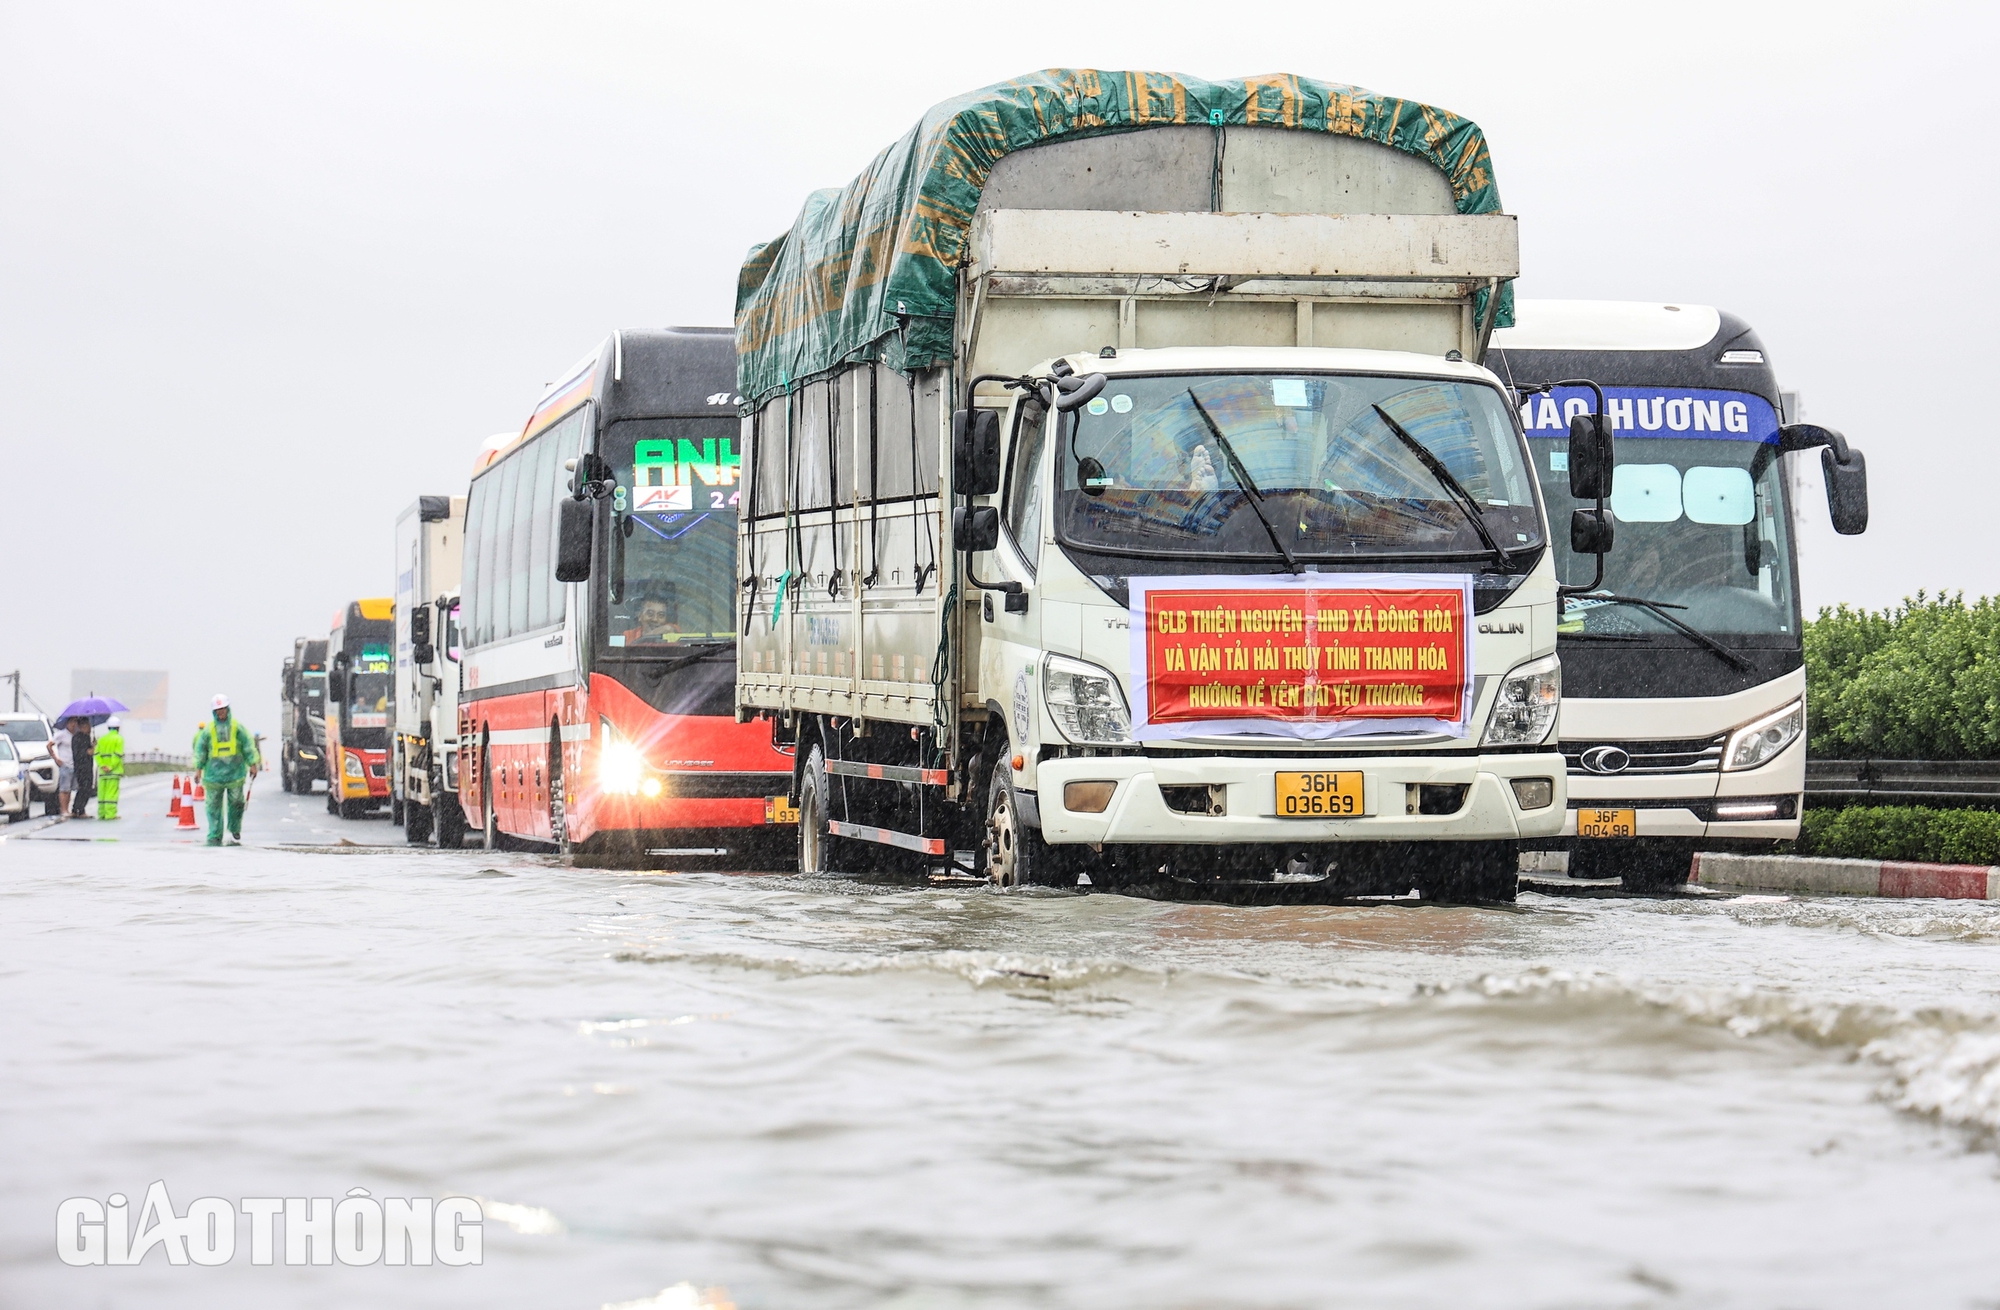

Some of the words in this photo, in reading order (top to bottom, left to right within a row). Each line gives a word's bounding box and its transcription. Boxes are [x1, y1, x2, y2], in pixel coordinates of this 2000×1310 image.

[1607, 396, 1749, 433] HƯƠNG
[1158, 610, 1187, 634] CLB
[1191, 604, 1236, 638] THIỆN
[1241, 604, 1302, 638] NGUYỆN
[1317, 609, 1349, 632] HND
[1353, 605, 1374, 632] XÃ
[1377, 604, 1419, 632] ĐÔNG
[1423, 604, 1453, 632] HÒA
[1478, 622, 1524, 634] OLLIN
[1165, 643, 1186, 671] VÀ
[1189, 643, 1221, 676] VẬN
[1224, 639, 1249, 671] TẢI
[1253, 639, 1279, 670] HẢI
[1283, 639, 1321, 670] THỦY
[1325, 638, 1360, 670] TỈNH
[1364, 647, 1414, 670] THANH
[1417, 642, 1448, 670] HÓA
[1189, 680, 1242, 708] HƯỚNG
[1246, 677, 1265, 707] VỀ
[1270, 680, 1299, 707] YÊN
[1303, 680, 1329, 707] BÁI
[1333, 679, 1361, 707] YÊU
[1365, 682, 1424, 706] THƯƠNG
[1301, 774, 1338, 792] 36H
[1286, 795, 1354, 814] 036.69
[779, 810, 800, 822] 93
[1594, 810, 1619, 823] 36F
[1583, 824, 1629, 837] 004.98
